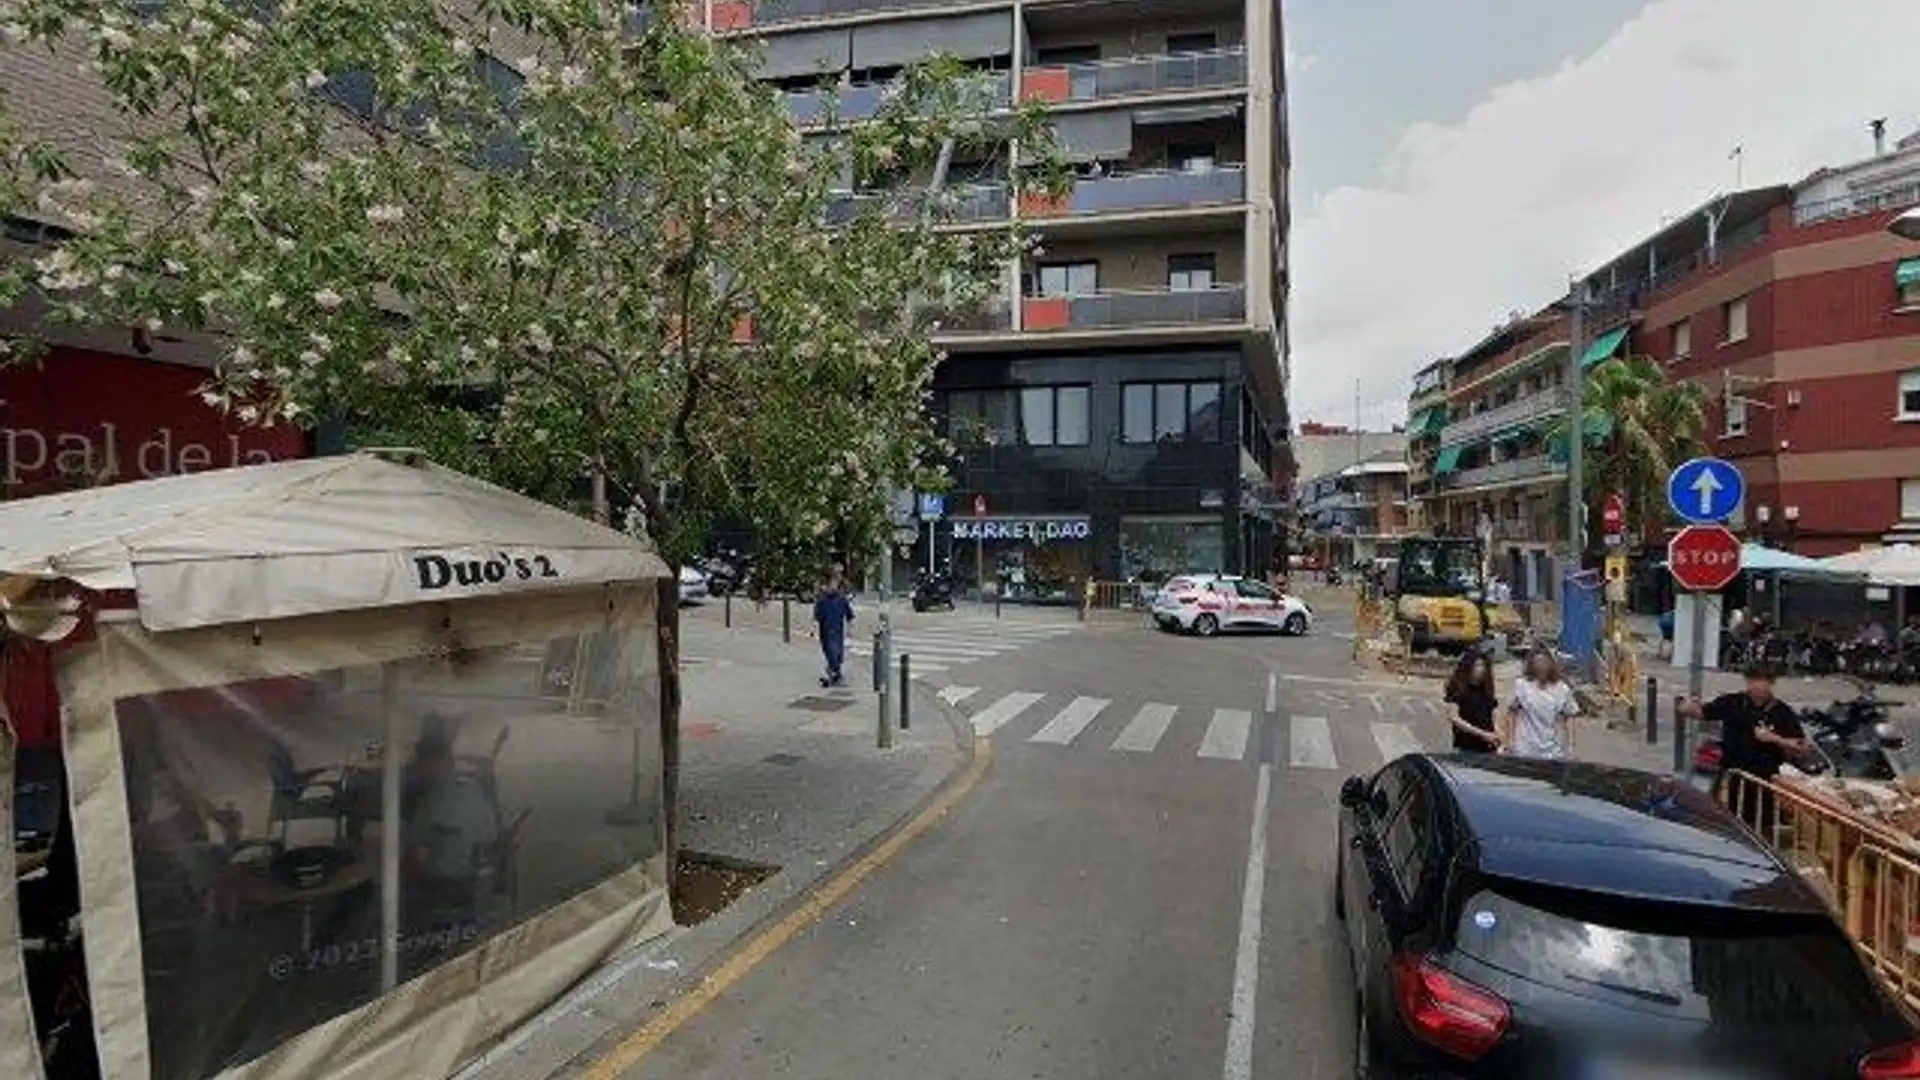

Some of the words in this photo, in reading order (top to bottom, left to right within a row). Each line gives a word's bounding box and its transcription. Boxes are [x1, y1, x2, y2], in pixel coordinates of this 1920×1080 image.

[3, 422, 119, 485] pal
[137, 428, 212, 478] de
[953, 521, 1036, 539] MARKET
[1046, 521, 1088, 539] DAO
[414, 552, 532, 589] Duo's
[533, 555, 558, 577] 2
[1676, 549, 1736, 566] STOP
